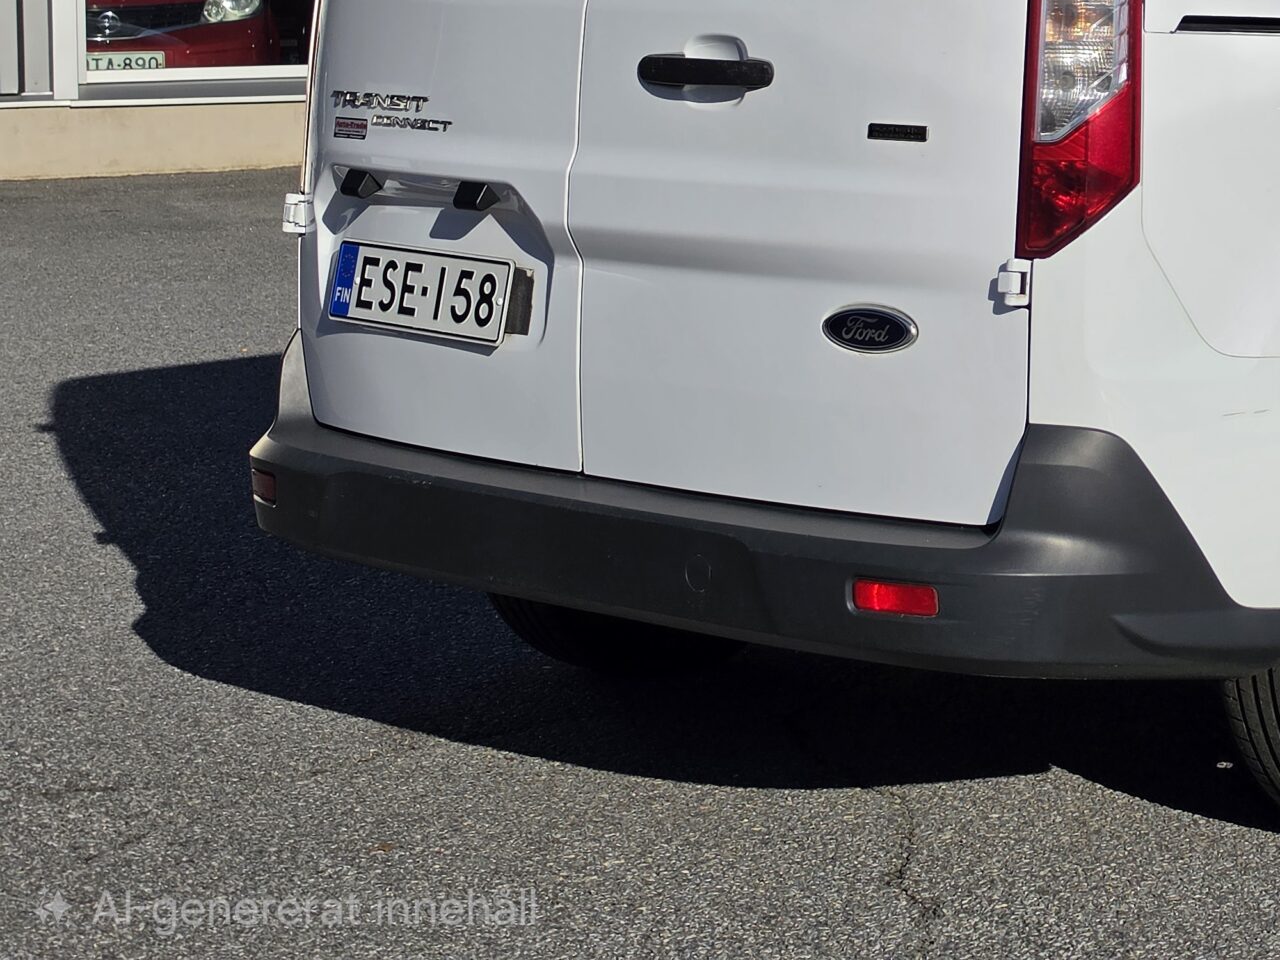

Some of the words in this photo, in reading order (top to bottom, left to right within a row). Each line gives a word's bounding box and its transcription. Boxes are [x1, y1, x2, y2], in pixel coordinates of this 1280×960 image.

[86, 56, 159, 69] TA-890
[331, 90, 429, 113] TRANSIT
[334, 286, 351, 304] FIN
[355, 255, 497, 328] ESE-158
[841, 315, 891, 343] Ford
